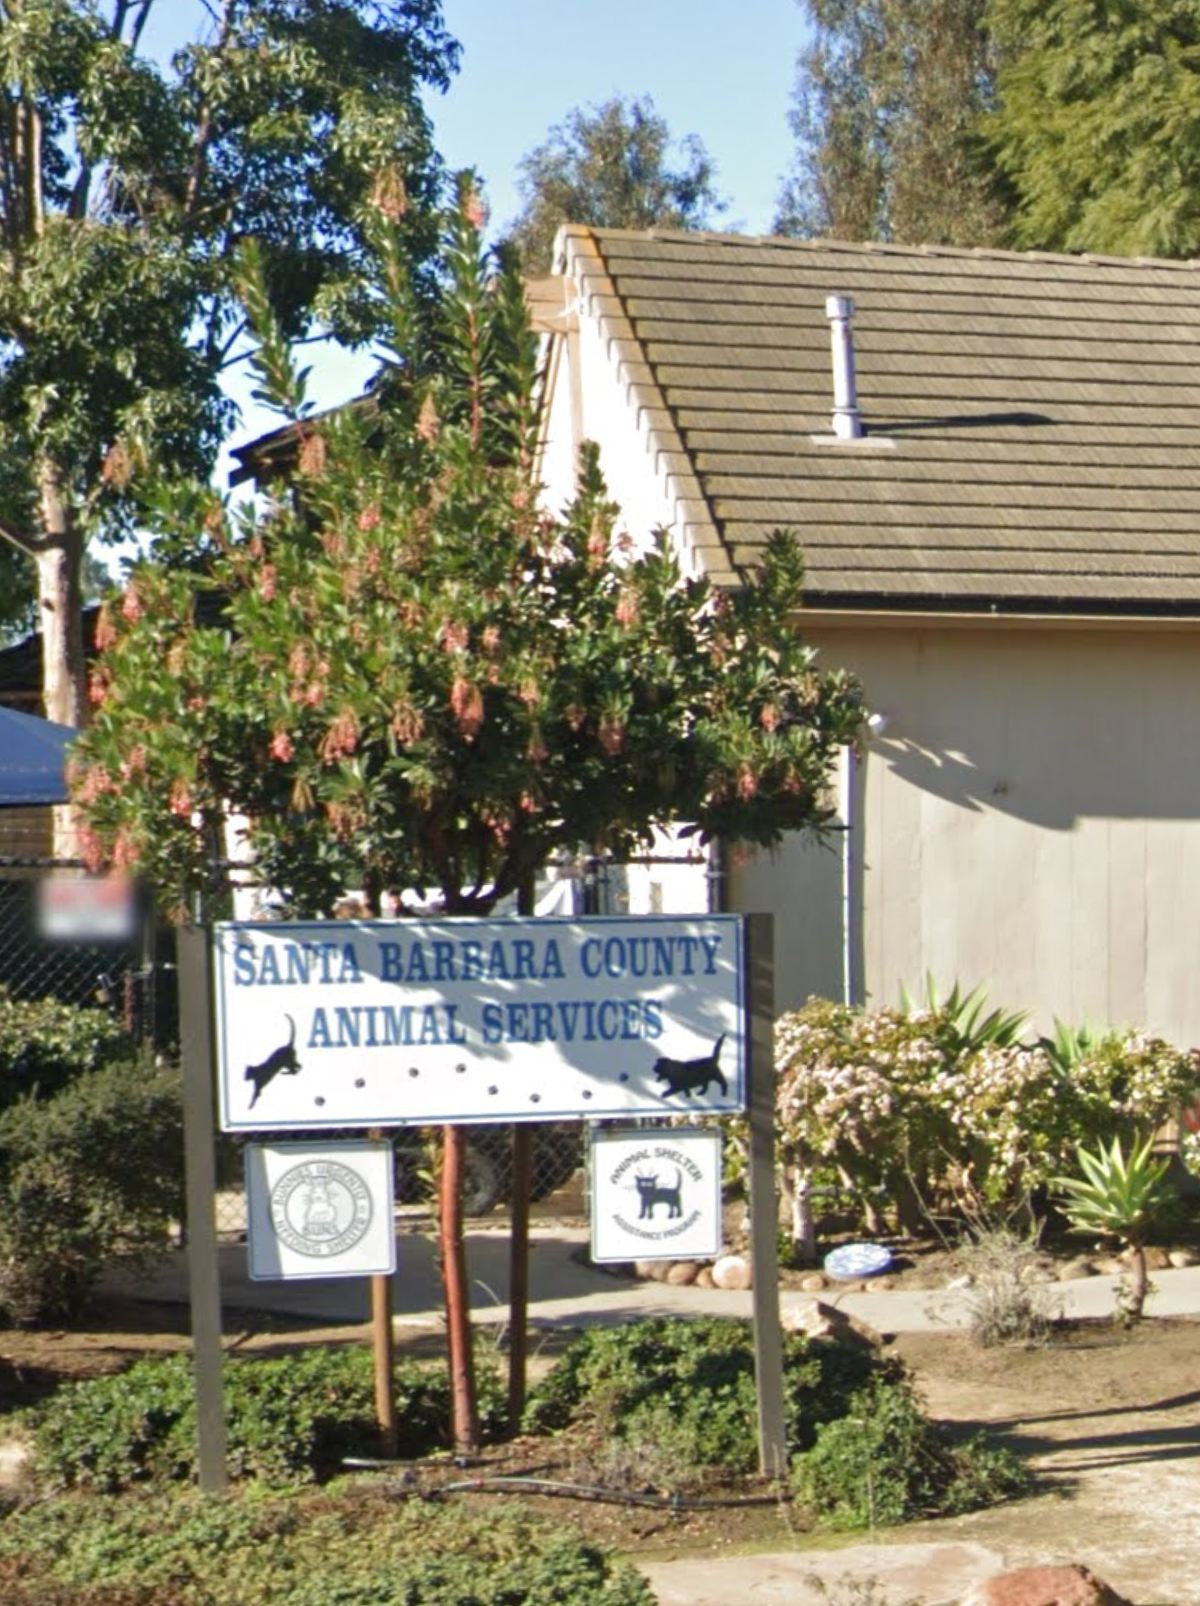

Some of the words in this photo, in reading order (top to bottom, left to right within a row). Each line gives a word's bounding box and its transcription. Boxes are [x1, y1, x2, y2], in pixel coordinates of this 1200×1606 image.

[233, 941, 364, 986] SANTA
[378, 938, 566, 983] BARBARA
[580, 935, 722, 978] COUNTY
[307, 1004, 467, 1048] ANIMAL
[482, 999, 664, 1044] SERVICES
[610, 1149, 651, 1185] ANIMAL
[654, 1147, 703, 1182] SHELTER
[275, 1219, 322, 1254] NEEDING
[327, 1217, 367, 1253] SHELTER
